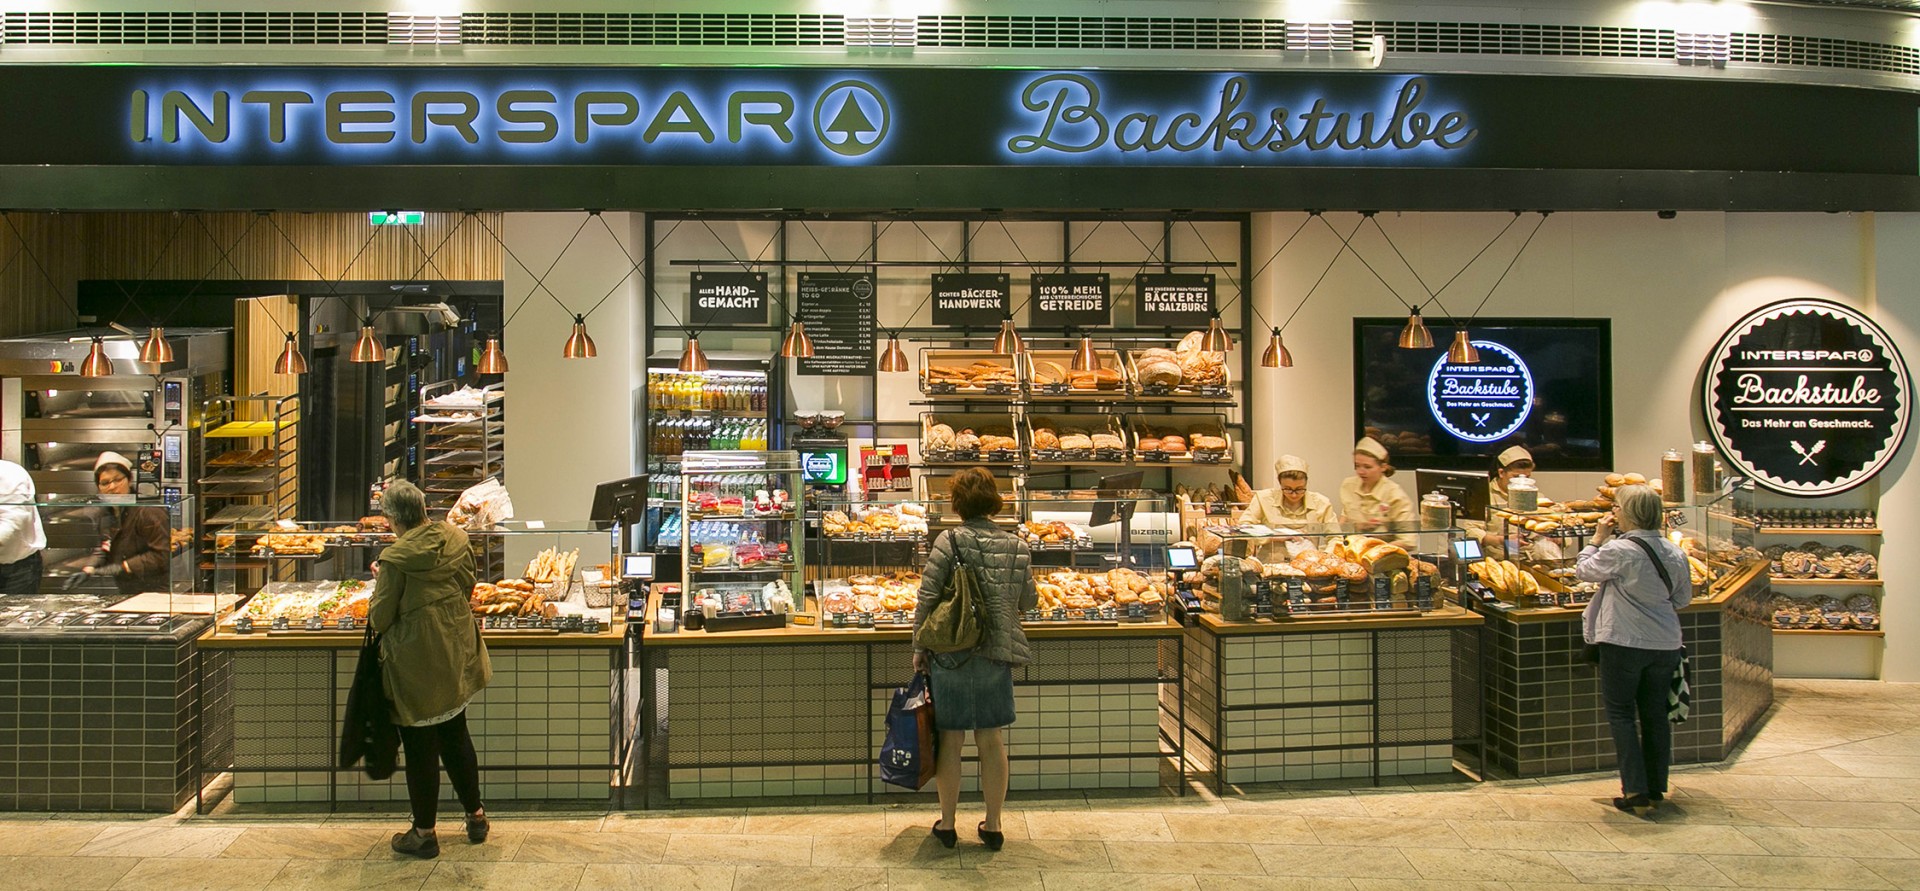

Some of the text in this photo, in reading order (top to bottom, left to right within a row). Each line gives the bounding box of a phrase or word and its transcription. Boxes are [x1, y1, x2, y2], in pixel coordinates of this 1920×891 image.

[130, 89, 796, 145] INTERSPAR
[1006, 73, 1479, 153] Backstube
[715, 286, 756, 296] HAND-
[961, 288, 1004, 298] BÄCKER-
[1039, 286, 1102, 295] 100% MEHL
[1145, 291, 1208, 302] BÄCKEREI
[698, 297, 760, 308] GEMACHT
[939, 299, 1001, 309] HANDWERK
[1040, 300, 1103, 311] GETREIDE
[1145, 303, 1208, 312] IN SALZBURG
[1741, 350, 1857, 361] INTERSPAR
[1442, 378, 1519, 395] Backstube
[1733, 373, 1882, 405] Backstube
[1742, 419, 1874, 429] Das Mehr an Geschmack.
